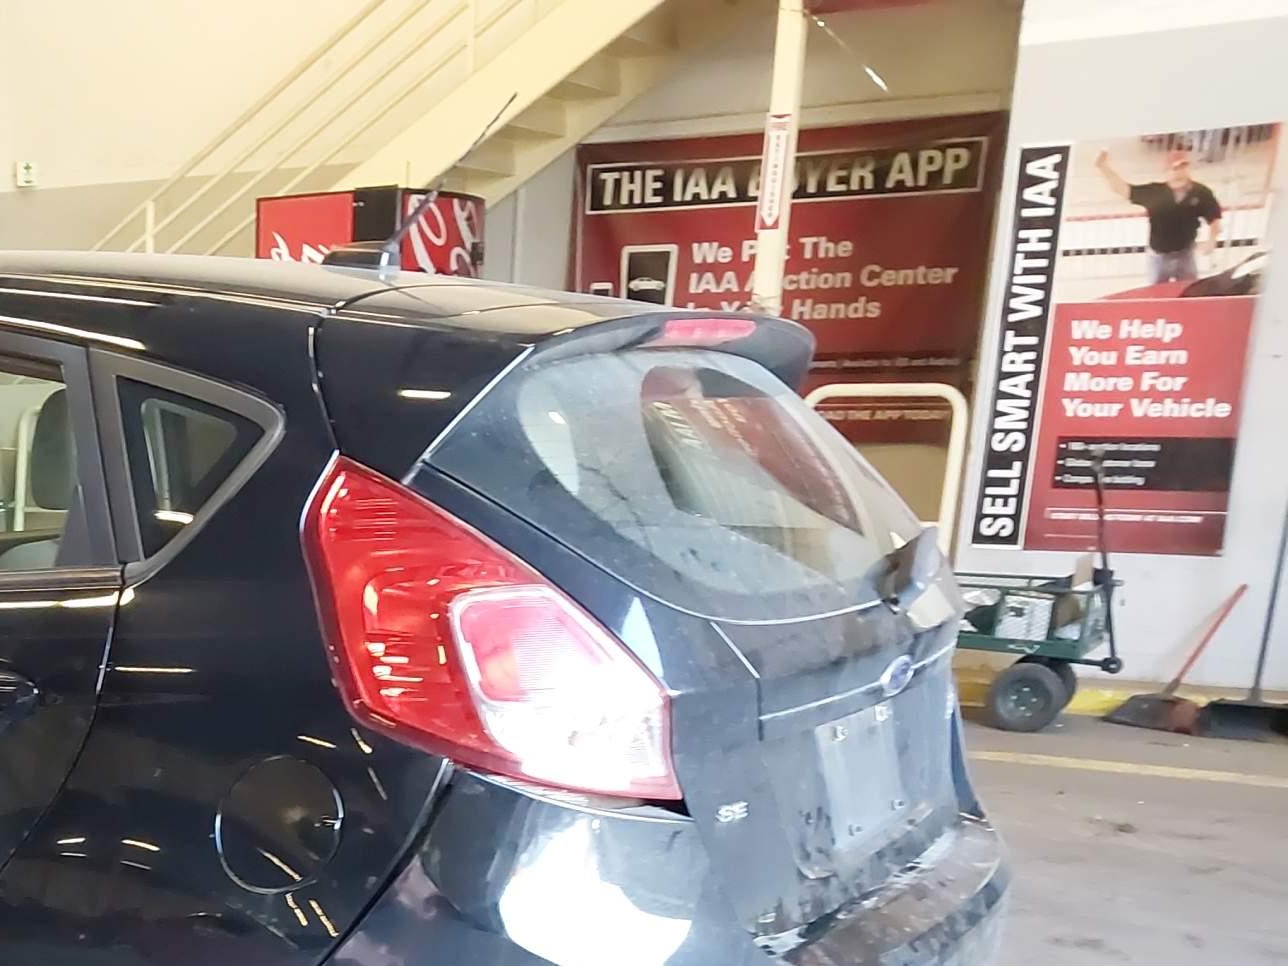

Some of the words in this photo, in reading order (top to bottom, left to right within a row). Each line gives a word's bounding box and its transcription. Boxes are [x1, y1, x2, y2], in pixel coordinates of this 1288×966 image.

[599, 168, 664, 206] THE
[673, 165, 737, 202] IAA
[746, 158, 878, 198] BYER
[886, 147, 970, 190] APP
[1021, 155, 1062, 217] IAA
[692, 242, 733, 263] We
[799, 236, 854, 259] The
[689, 270, 739, 293] IAA
[860, 264, 957, 288] Center
[1007, 225, 1054, 322] WITH
[792, 295, 881, 320] Hands
[1070, 320, 1113, 340] We
[1118, 319, 1183, 343] Help
[1068, 346, 1117, 366] You
[1124, 346, 1188, 366] Earn
[990, 329, 1042, 451] SMART
[1063, 372, 1134, 392] More
[1140, 373, 1187, 392] For
[1062, 398, 1123, 418] Your
[1130, 398, 1233, 418] Vehicle
[979, 458, 1024, 537] SELL
